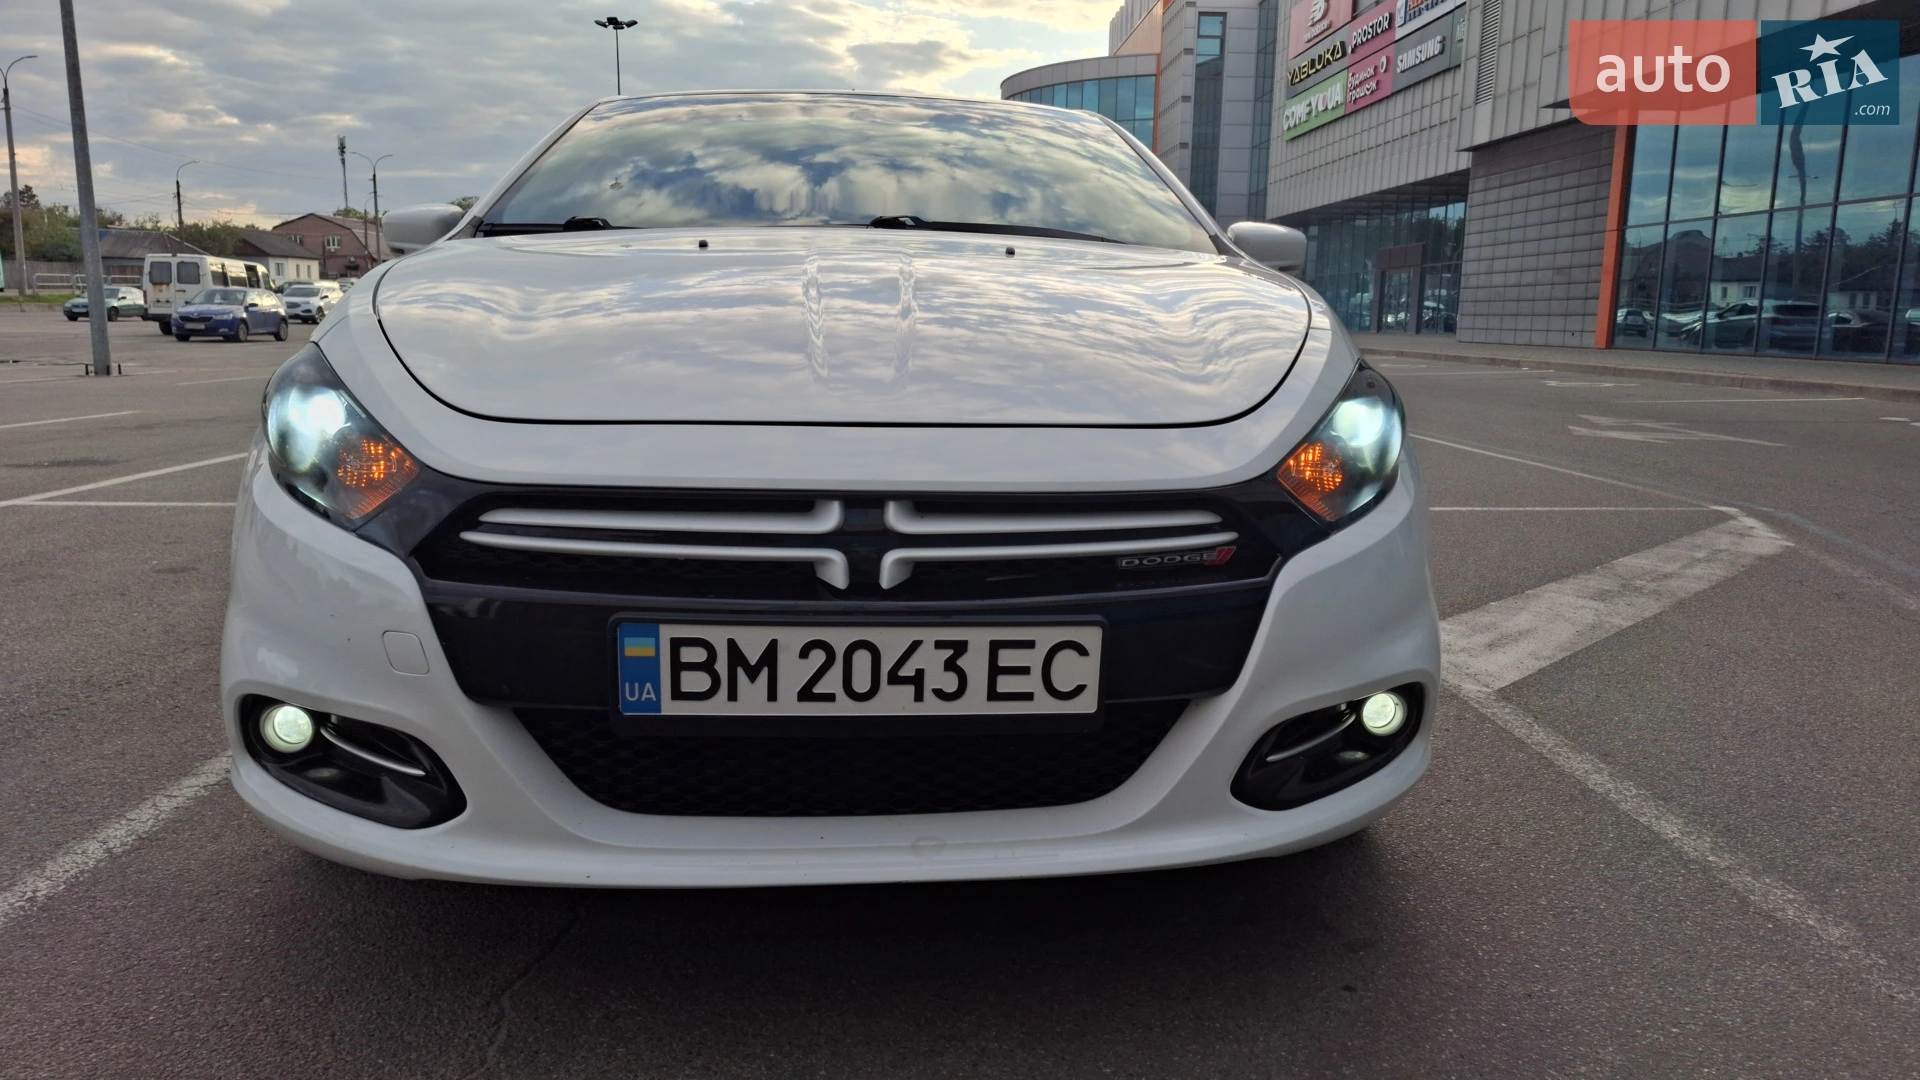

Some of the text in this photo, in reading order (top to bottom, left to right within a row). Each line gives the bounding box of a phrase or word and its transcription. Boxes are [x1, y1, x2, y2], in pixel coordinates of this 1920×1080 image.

[1352, 12, 1390, 48] PROSTOR
[1287, 41, 1343, 85] YABLUKA
[1397, 35, 1444, 74] SAMSUNG
[1121, 551, 1217, 568] DODGE
[669, 637, 1090, 702] BM 2043 EC
[625, 682, 656, 702] UA
